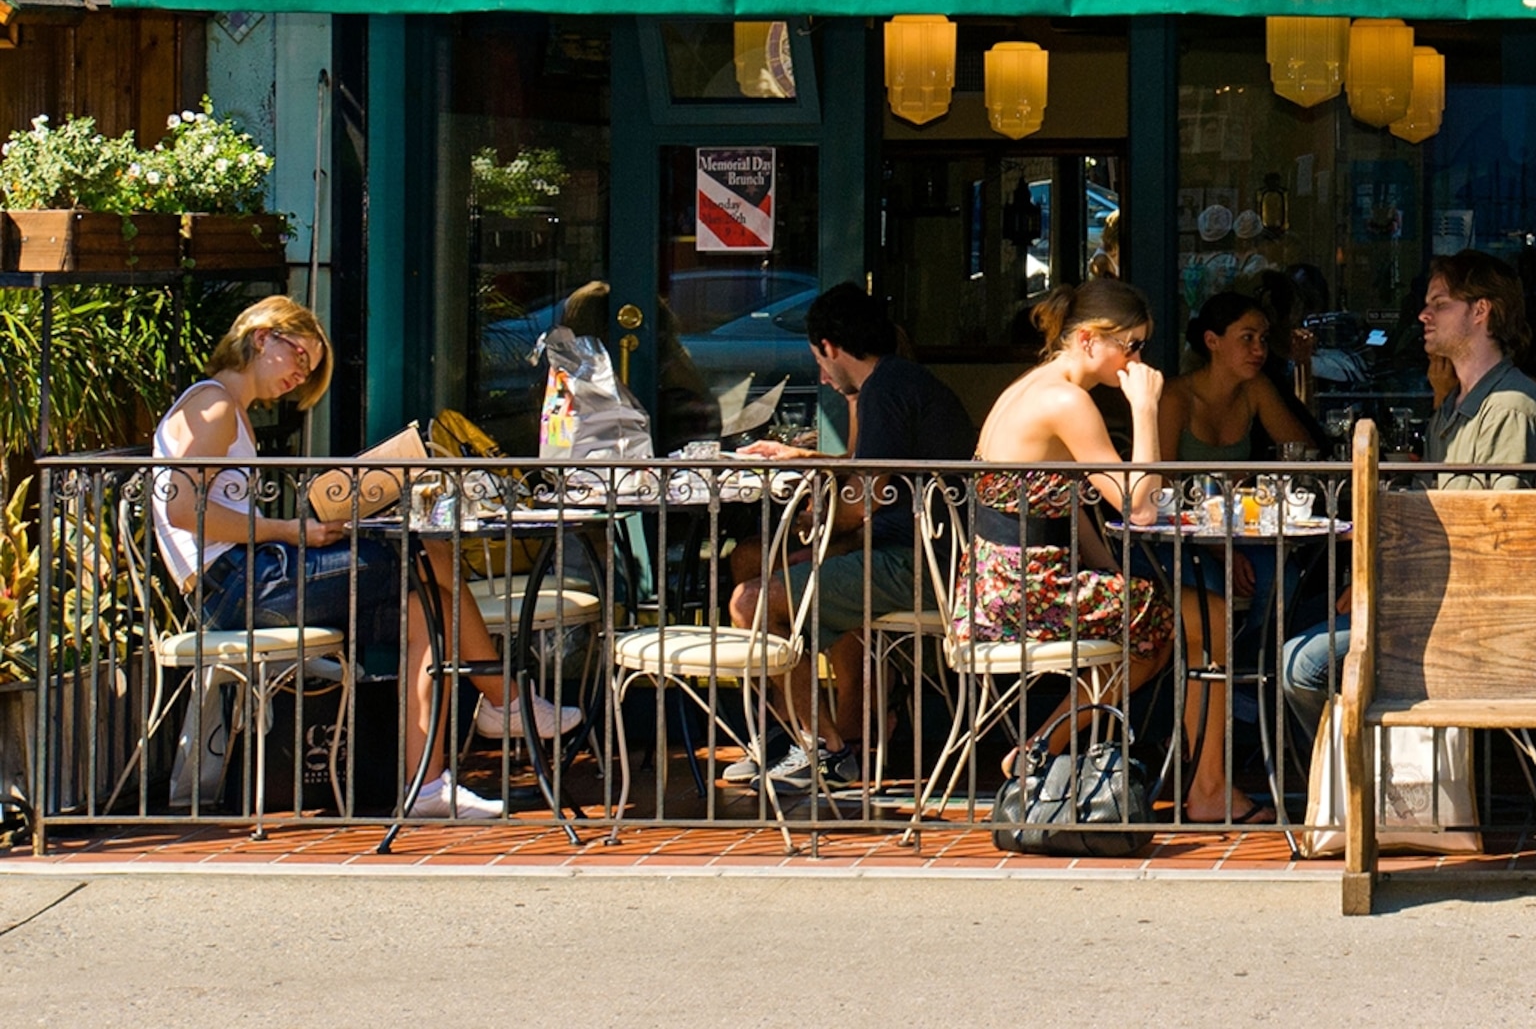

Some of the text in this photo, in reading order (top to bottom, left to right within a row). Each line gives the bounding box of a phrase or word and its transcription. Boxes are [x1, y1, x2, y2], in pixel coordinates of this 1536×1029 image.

[700, 156, 772, 175] Memorial Day
[728, 171, 764, 185] Brunch
